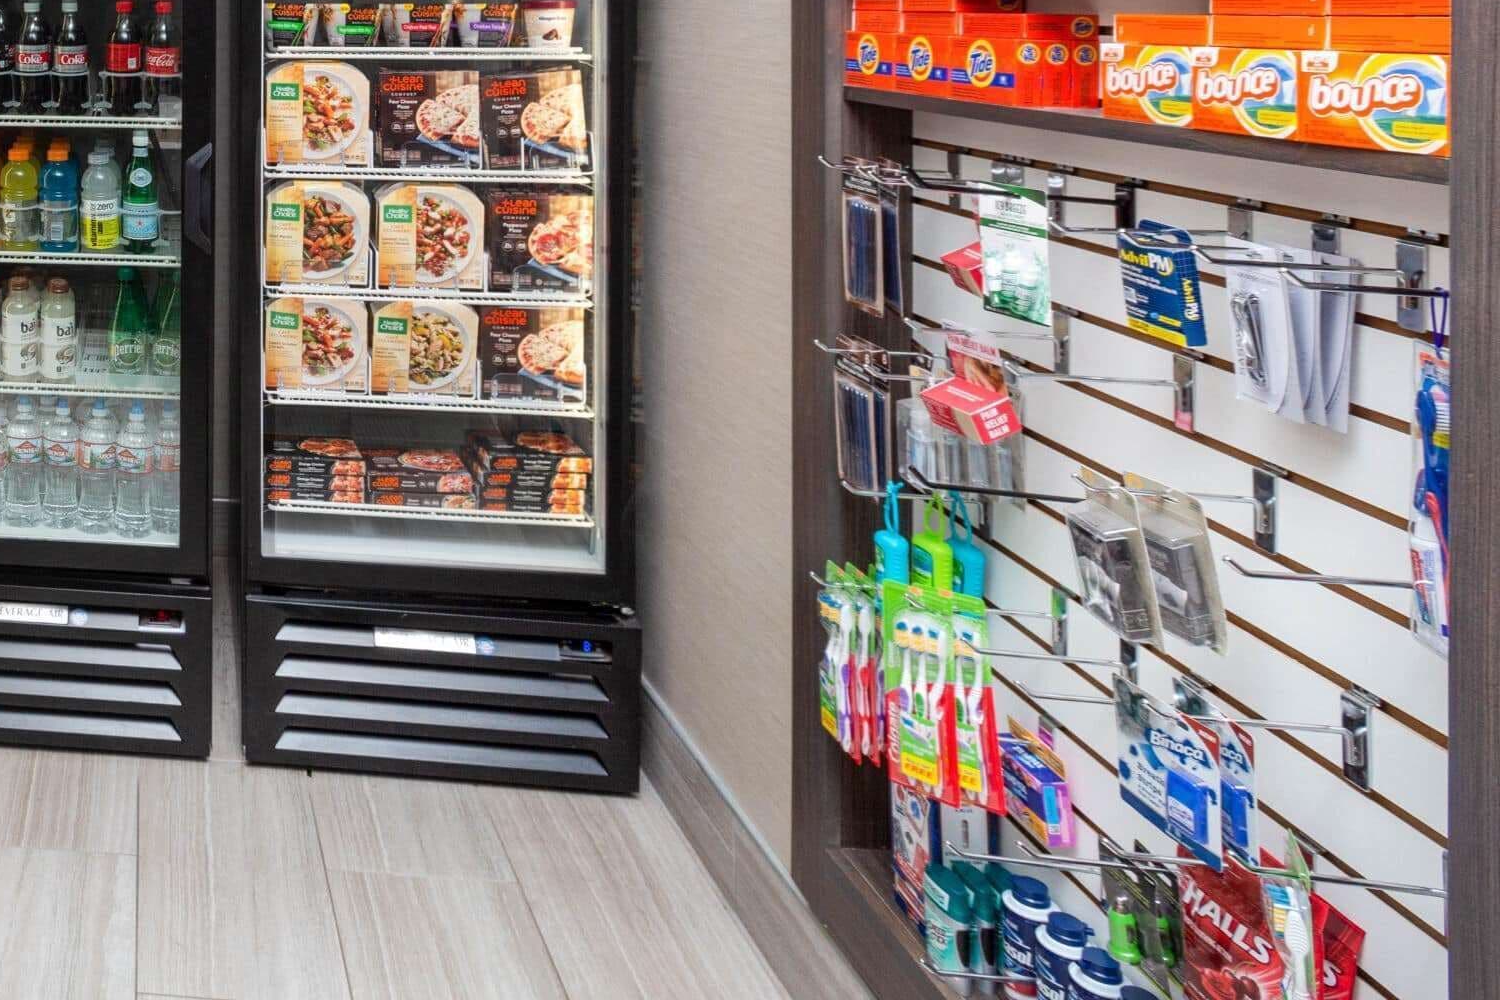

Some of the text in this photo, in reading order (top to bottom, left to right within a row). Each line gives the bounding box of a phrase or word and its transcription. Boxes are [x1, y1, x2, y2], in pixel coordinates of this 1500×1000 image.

[18, 54, 43, 64] Coke
[60, 54, 85, 65] Coke
[859, 44, 877, 64] Tide
[910, 47, 930, 69] Tide
[970, 52, 993, 75] Tide
[1107, 62, 1179, 95] bounce
[1198, 69, 1279, 105] bounce
[1311, 75, 1421, 115] bounce
[97, 202, 114, 211] zero
[56, 323, 74, 337] bai
[1150, 729, 1204, 761] Binaca
[1183, 885, 1274, 964] HALLS
